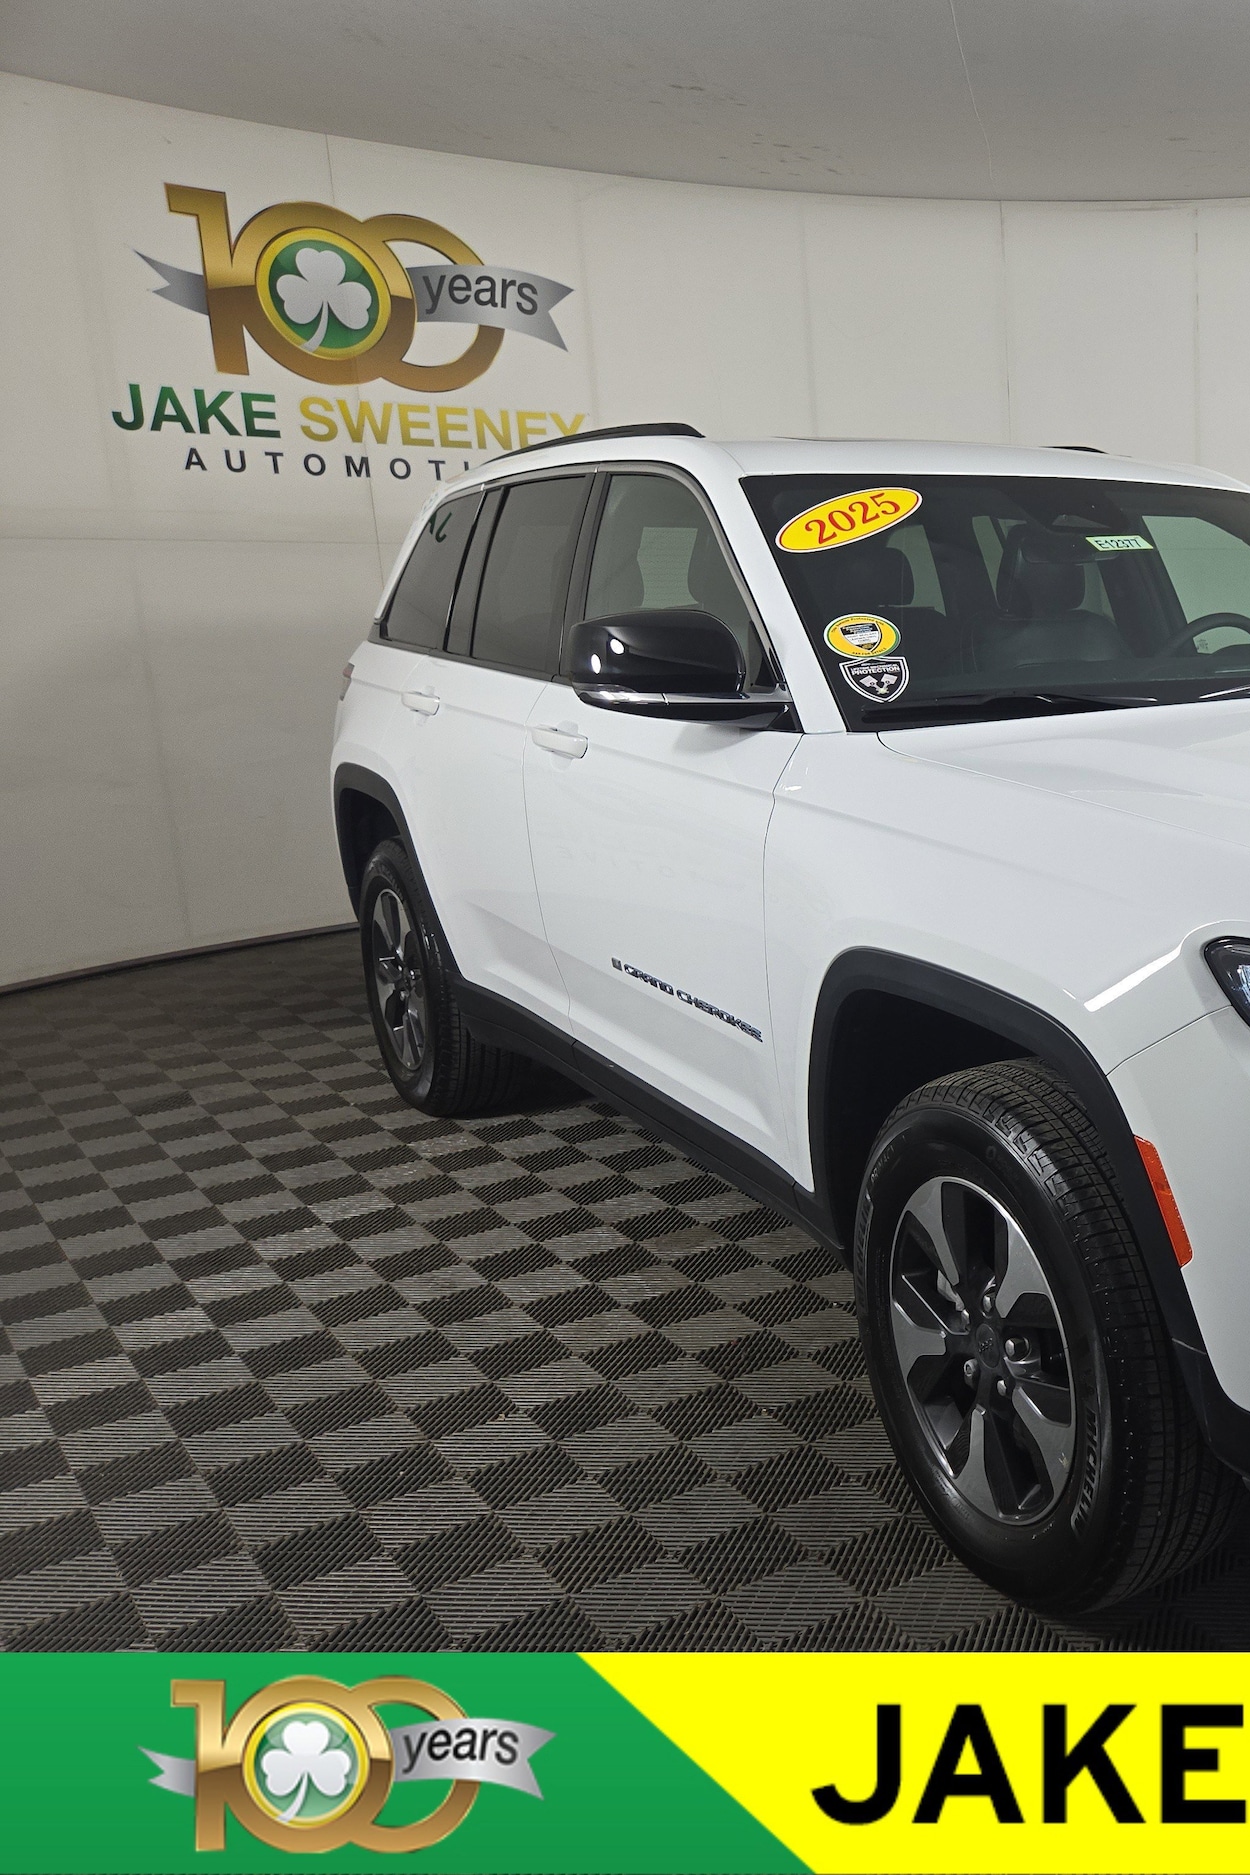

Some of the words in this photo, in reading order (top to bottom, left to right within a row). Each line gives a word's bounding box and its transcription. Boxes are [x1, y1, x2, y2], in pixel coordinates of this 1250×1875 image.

[164, 182, 505, 394] 100
[422, 274, 538, 316] years
[112, 383, 281, 439] JAKE
[299, 396, 586, 451] SWEENEY
[185, 447, 470, 482] AUTOMOT
[804, 492, 900, 545] 2025
[623, 963, 675, 996] GRAND
[676, 989, 763, 1043] CHEROKEE
[1075, 1406, 1100, 1536] MICHELIN
